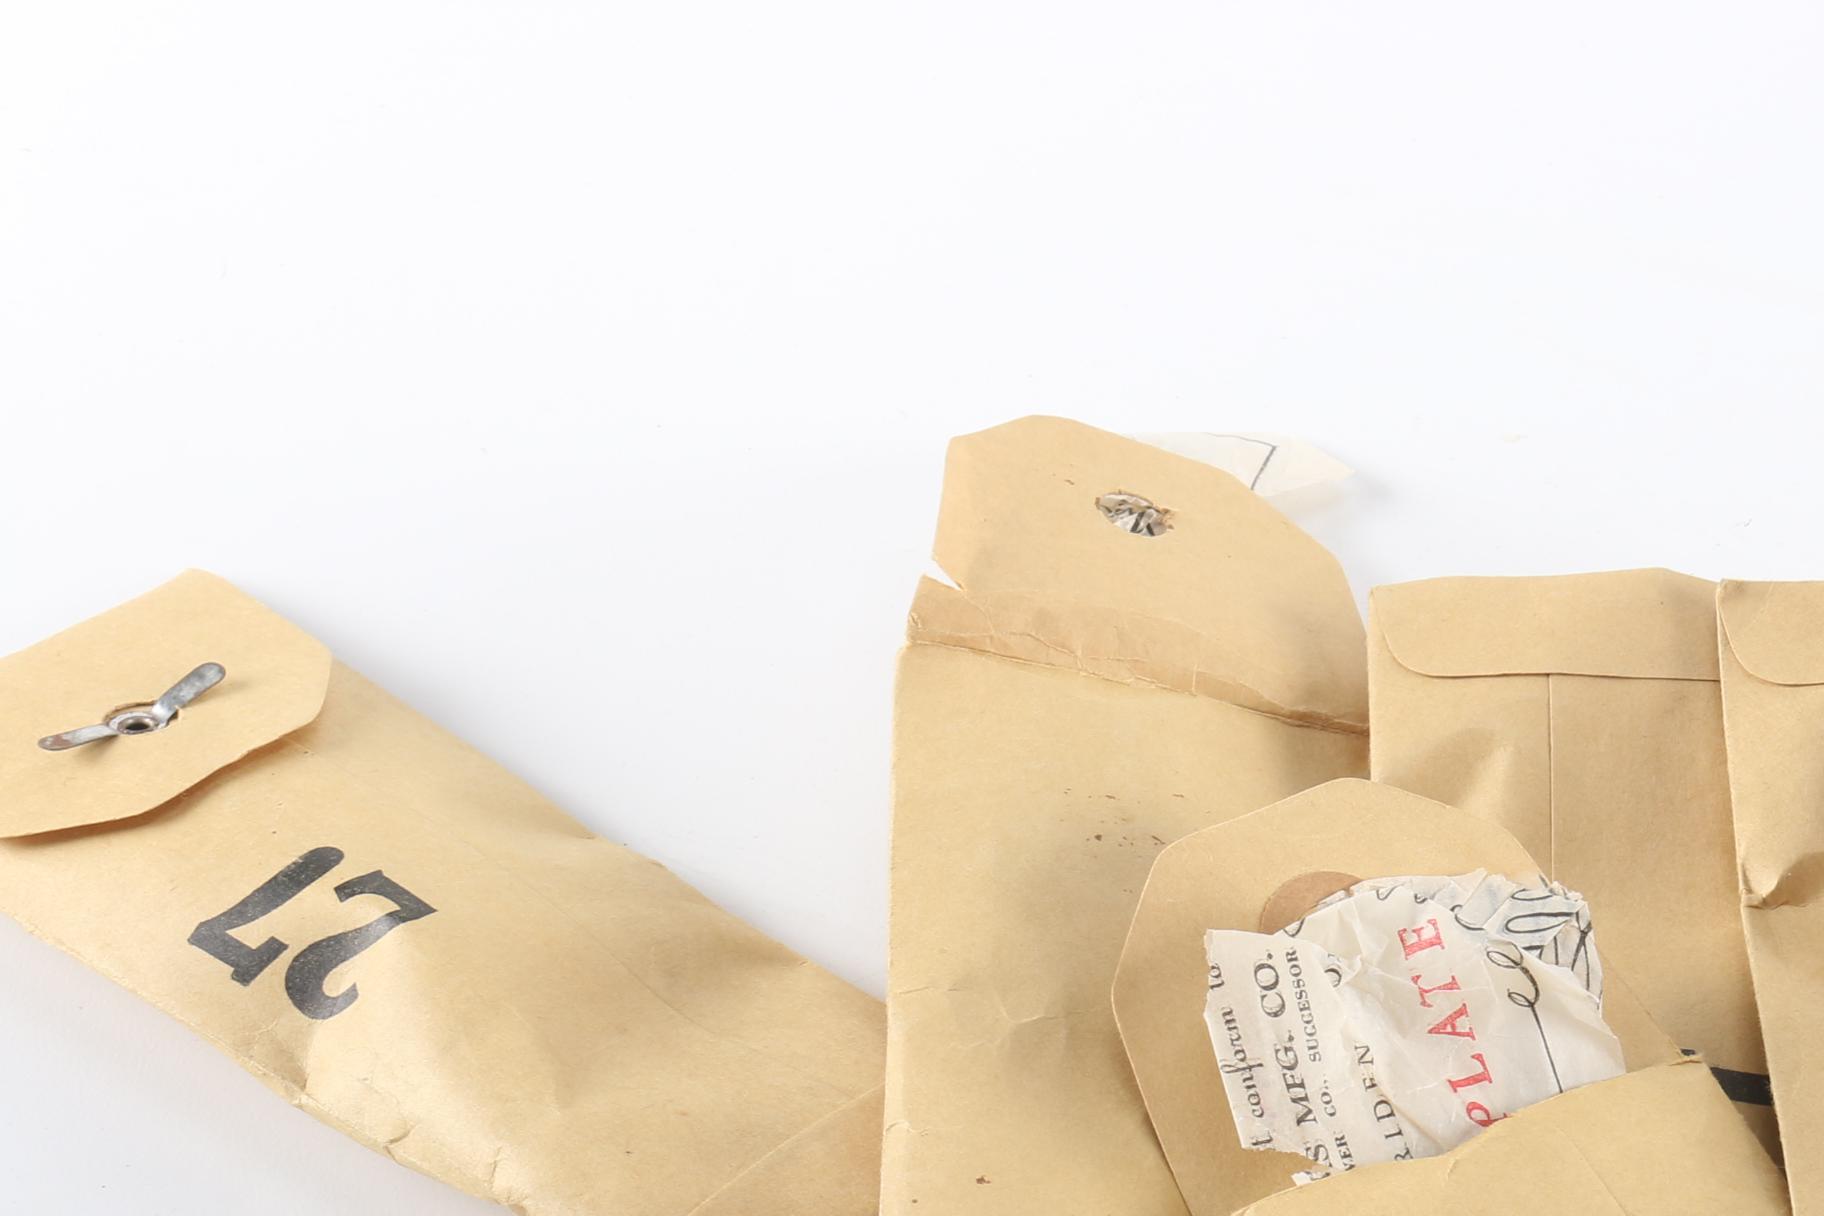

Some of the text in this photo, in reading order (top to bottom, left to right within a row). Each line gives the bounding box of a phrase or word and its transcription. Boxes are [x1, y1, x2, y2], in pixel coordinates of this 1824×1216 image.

[187, 845, 438, 1021] 27
[1253, 950, 1287, 1019] CO.
[1219, 1006, 1265, 1119] conform
[1285, 948, 1322, 1063] SUCCESSOR
[1397, 918, 1514, 1128] PLATE
[1273, 1033, 1319, 1127] MFG.
